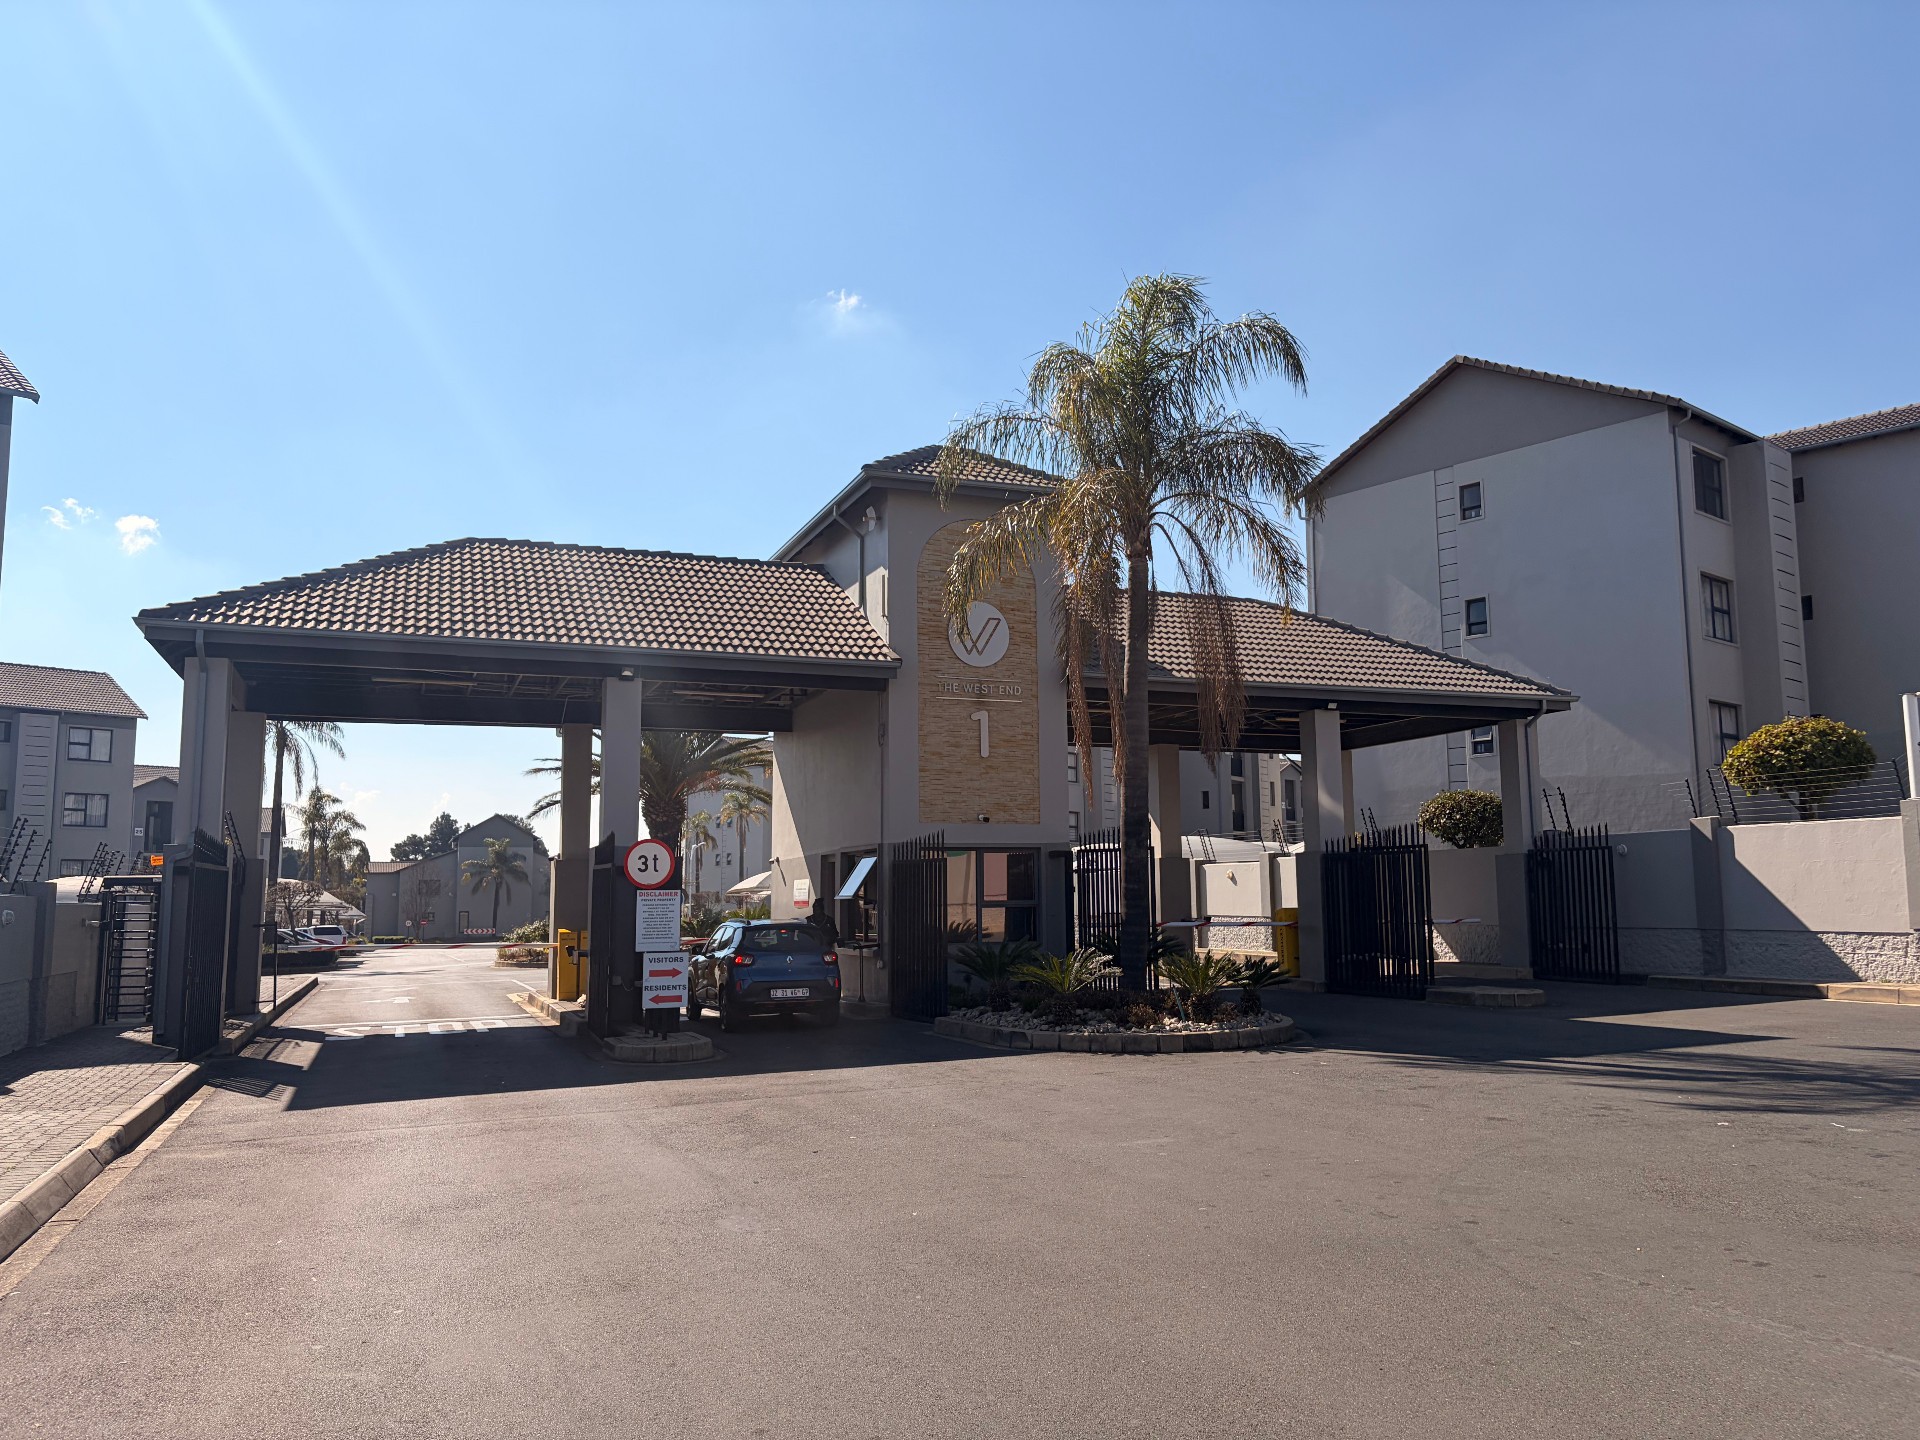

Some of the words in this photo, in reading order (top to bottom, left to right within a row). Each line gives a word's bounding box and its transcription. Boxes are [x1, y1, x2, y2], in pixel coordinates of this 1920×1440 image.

[937, 682, 959, 693] THE
[963, 683, 995, 694] WEST
[999, 685, 1022, 696] END
[971, 710, 990, 758] 1
[648, 956, 684, 964] VISITORS
[644, 984, 687, 992] RESIDENTS
